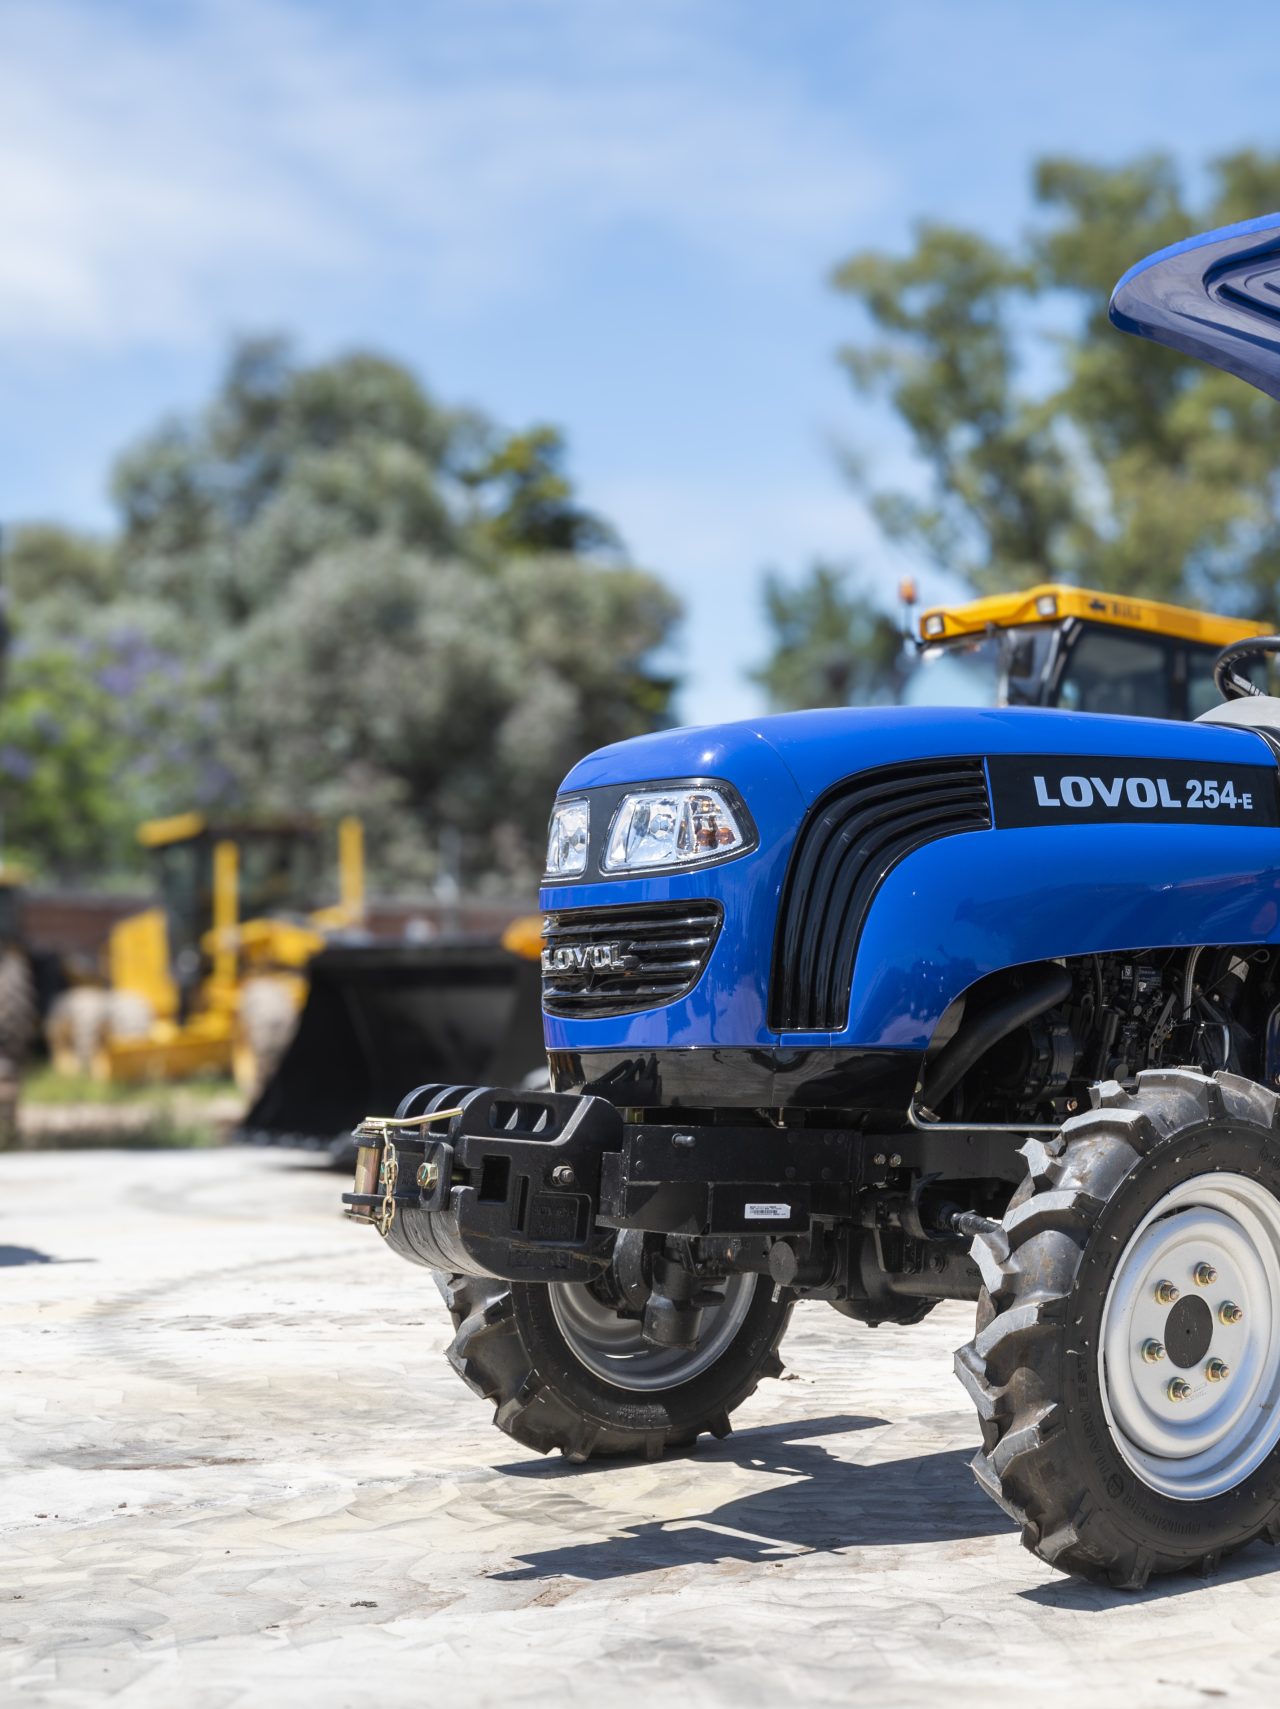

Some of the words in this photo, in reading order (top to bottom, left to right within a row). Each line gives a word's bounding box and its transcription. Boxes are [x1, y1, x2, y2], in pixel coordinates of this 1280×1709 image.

[1033, 775, 1182, 808] LOVOL
[1186, 780, 1254, 810] 254-E
[541, 941, 625, 971] LOVOL
